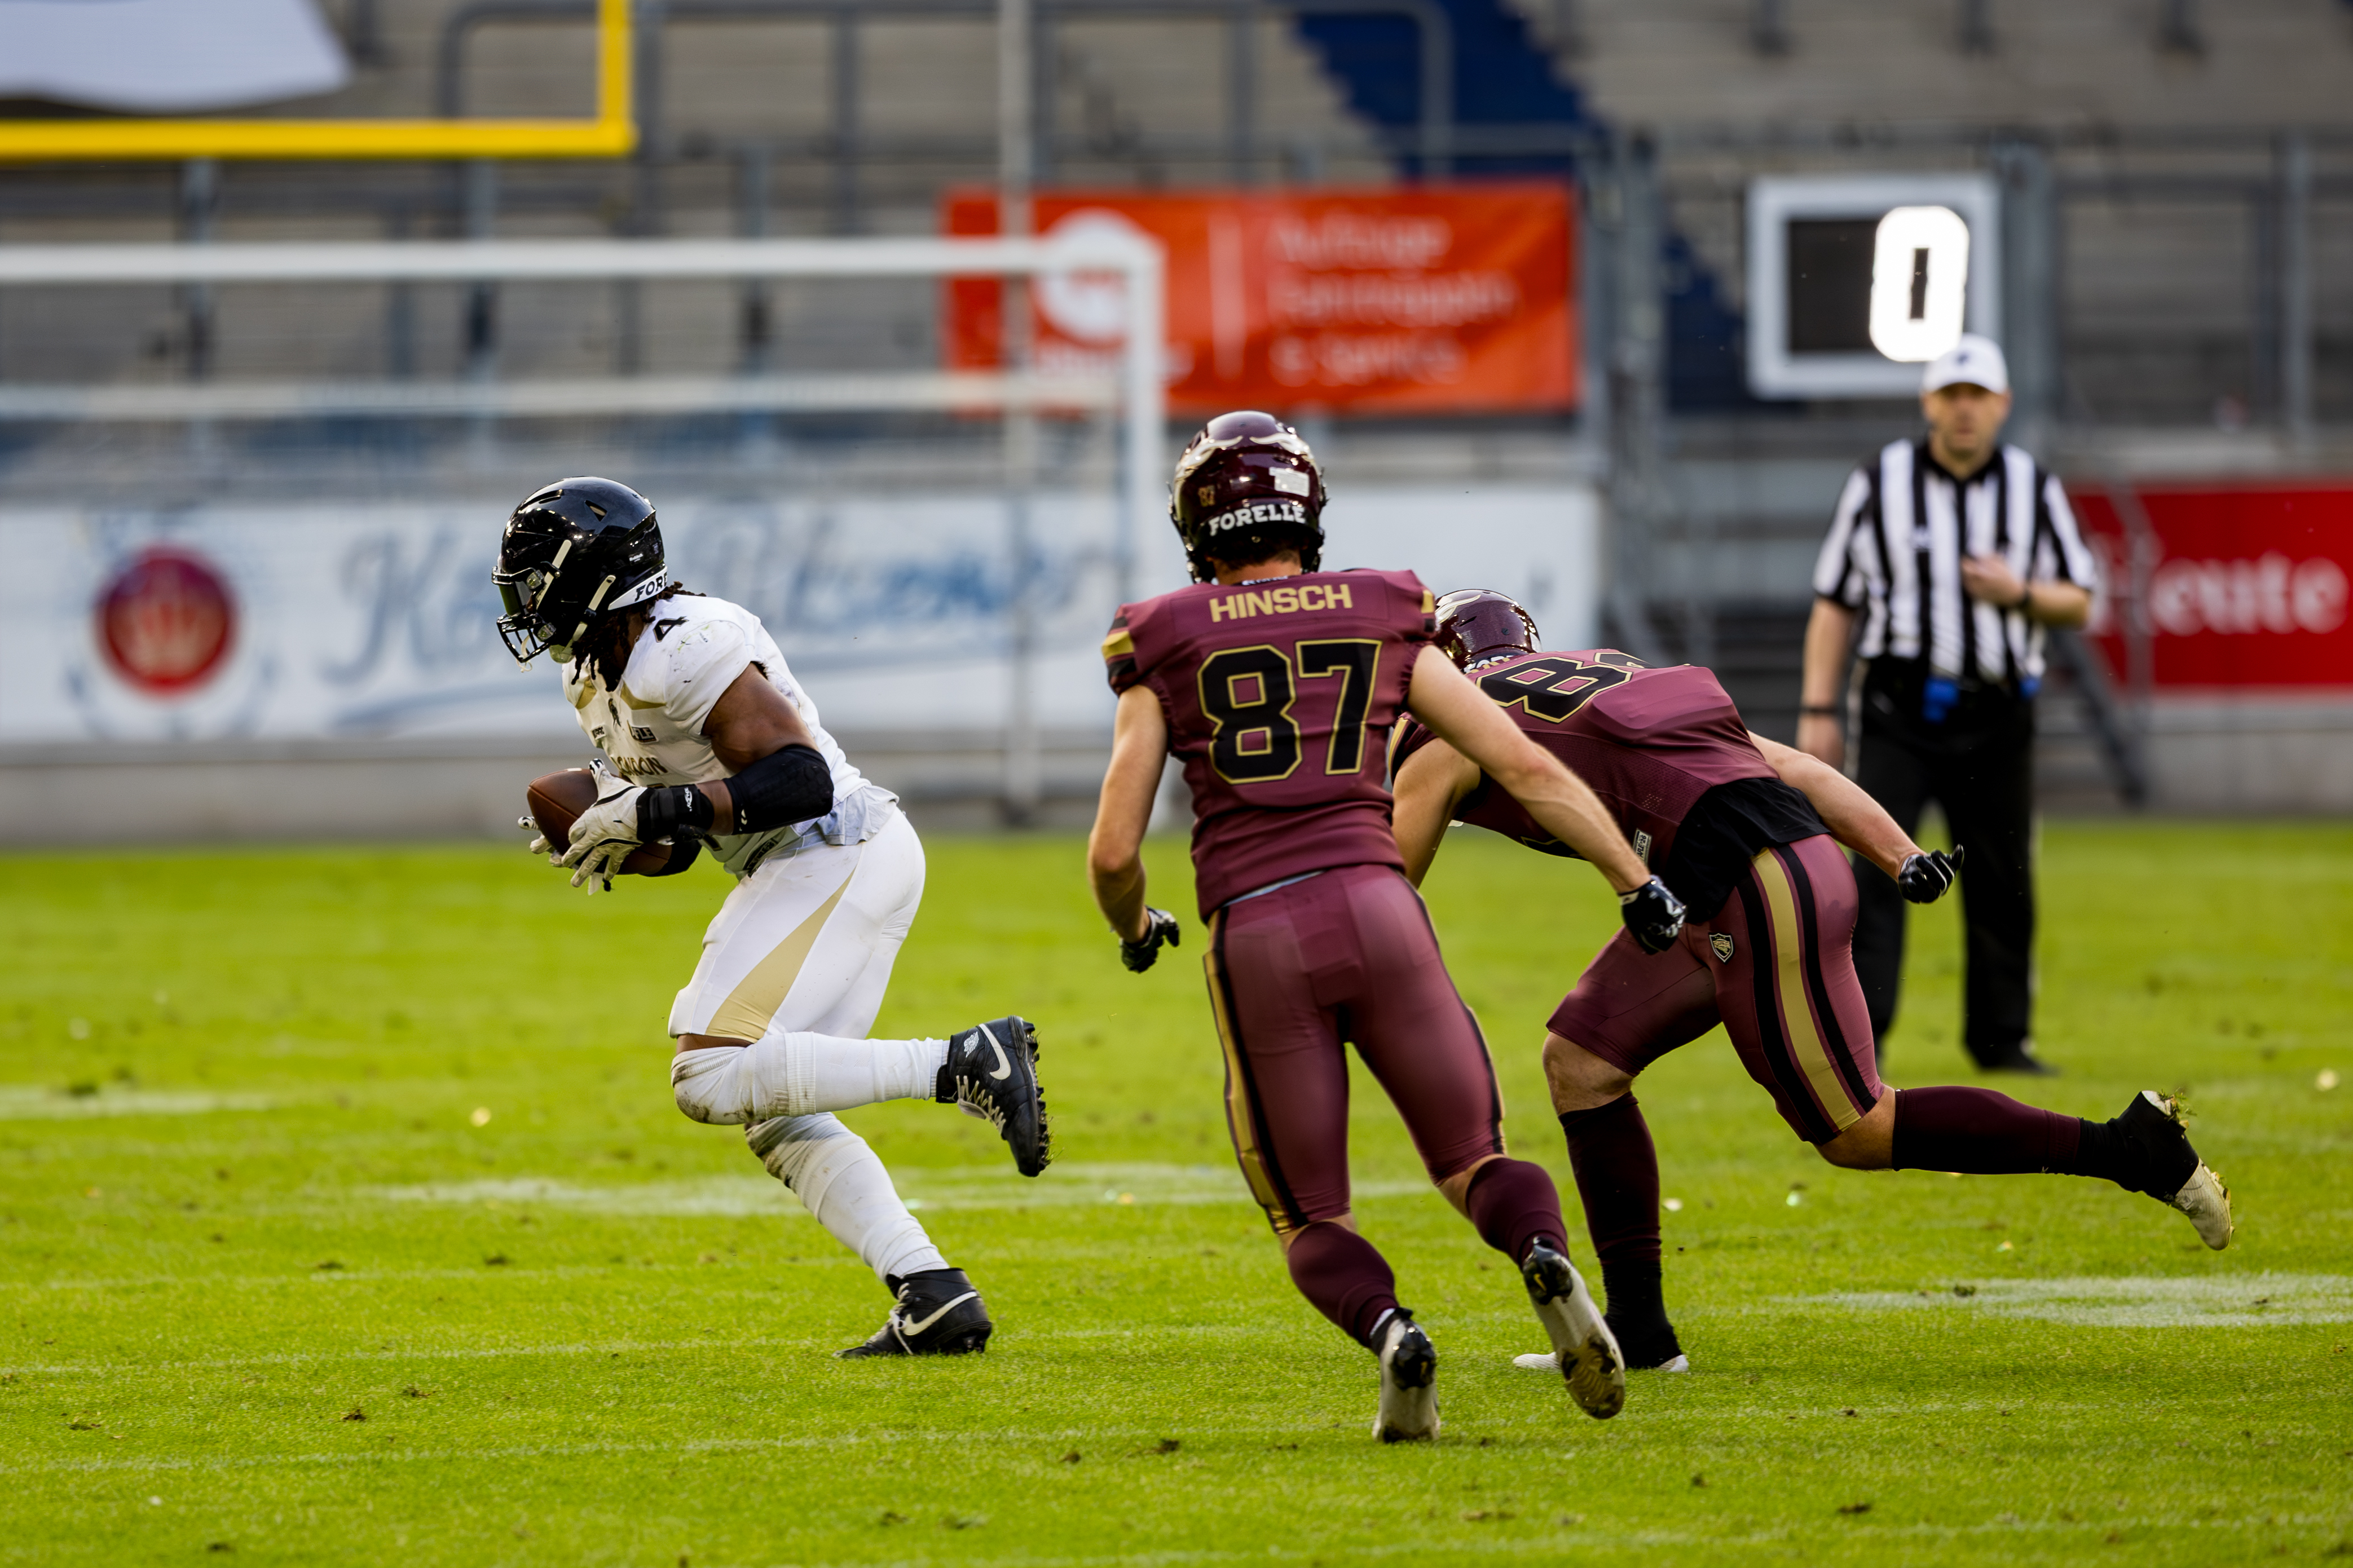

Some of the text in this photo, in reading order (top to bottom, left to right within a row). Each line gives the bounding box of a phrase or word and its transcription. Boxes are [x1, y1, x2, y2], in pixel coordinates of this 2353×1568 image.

[1869, 206, 1969, 362] 0
[1208, 504, 1306, 537] FORELLE
[1209, 584, 1352, 622] HINSCH
[653, 616, 689, 643] 4
[1197, 638, 1382, 785] 87
